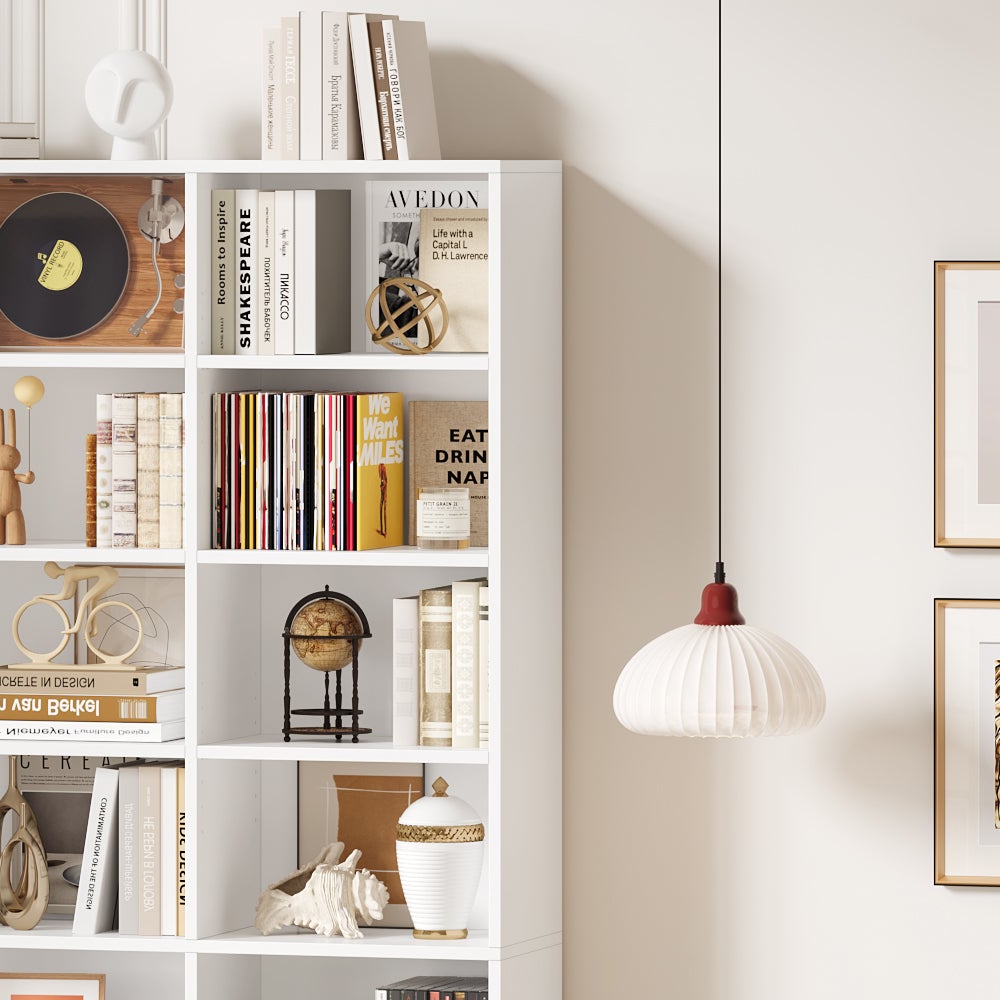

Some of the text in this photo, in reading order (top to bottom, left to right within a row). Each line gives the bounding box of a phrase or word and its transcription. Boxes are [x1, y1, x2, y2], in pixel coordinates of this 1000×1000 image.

[328, 75, 342, 150] Братья Карамазовы
[390, 68, 406, 140] ГОВОРИ КАК БОГ
[385, 190, 480, 208] AVEDON
[432, 229, 448, 238] Life
[449, 229, 467, 238] with
[216, 200, 228, 305] Rooms to Inspire
[432, 240, 468, 250] Capital L
[40, 241, 65, 283] VINYL RECORD
[432, 251, 489, 260] D. H. Lawrence
[239, 208, 251, 348] SHAKESPEARE
[280, 273, 290, 321] ПИКАССО
[368, 395, 391, 415] We
[363, 416, 399, 441] Want
[449, 429, 489, 442] EAT
[357, 439, 404, 467] MILES
[435, 449, 487, 463] DRIN
[447, 471, 489, 485] NAP
[20, 755, 126, 770] CEREA
